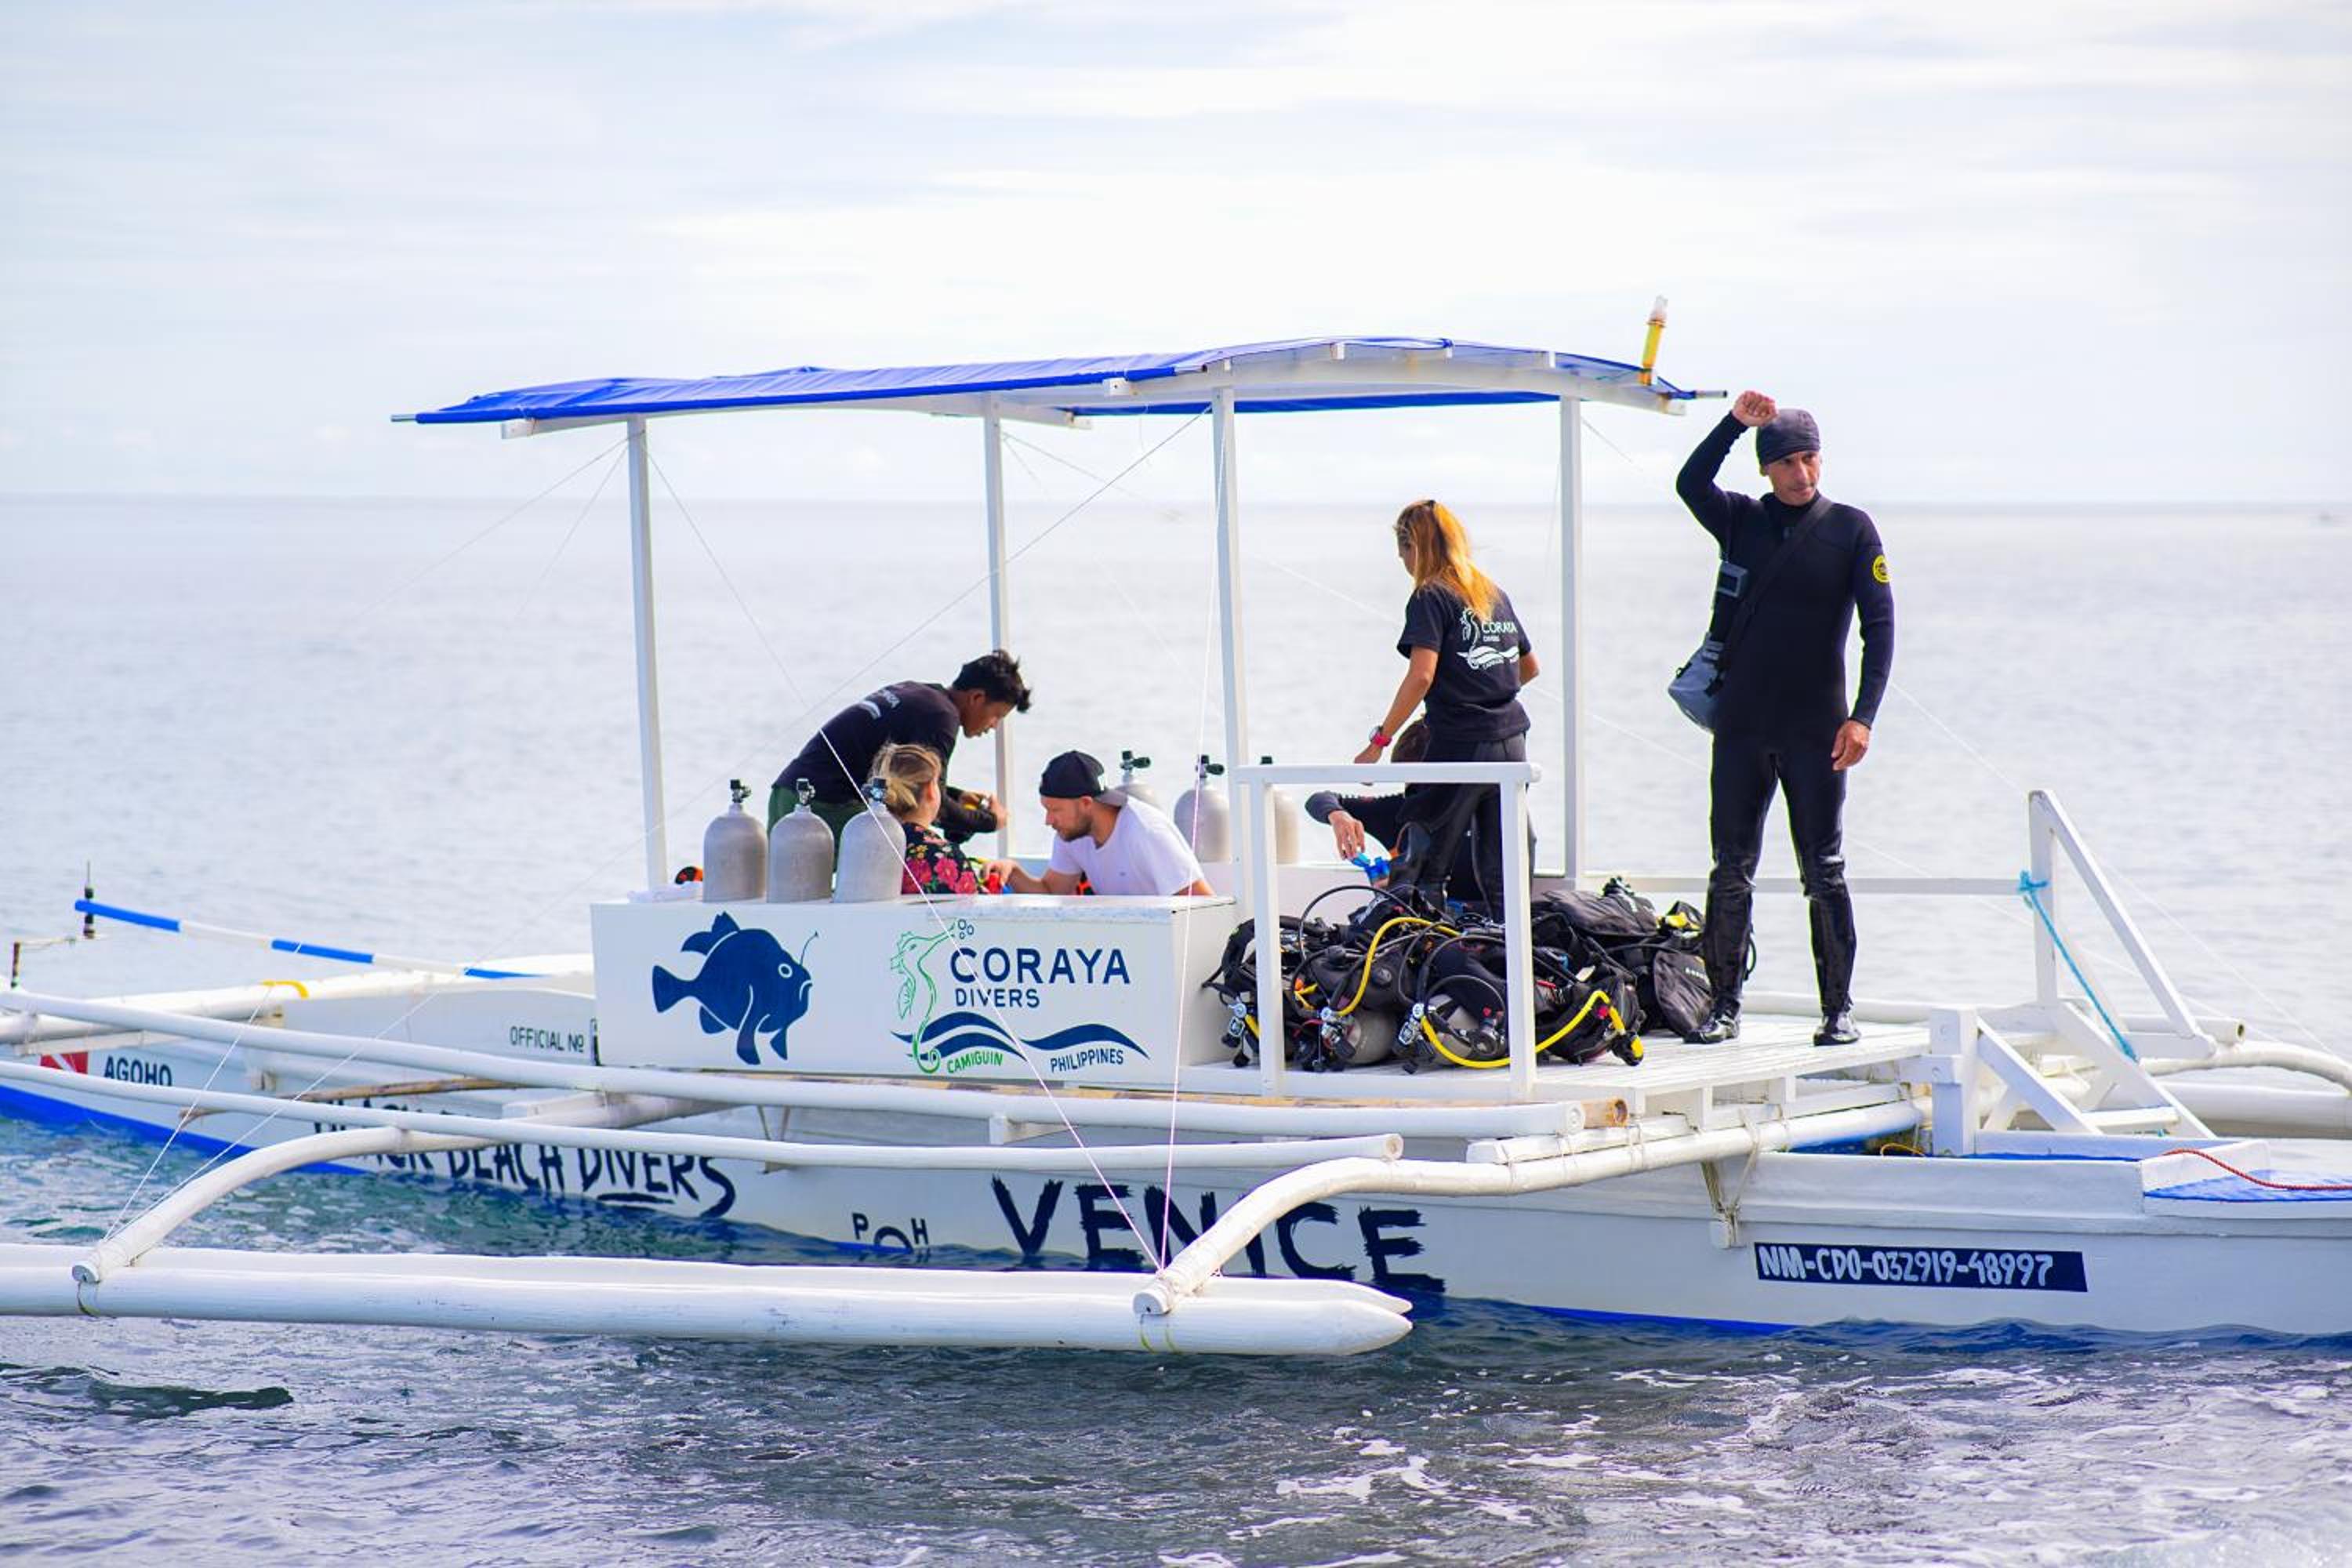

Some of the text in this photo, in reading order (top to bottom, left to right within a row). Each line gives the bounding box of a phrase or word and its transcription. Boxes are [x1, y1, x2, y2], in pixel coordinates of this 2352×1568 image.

[950, 947, 1131, 984] CORAYA
[956, 989, 1040, 1008] DIVERS
[510, 1025, 564, 1051] OFFICIAL
[103, 1055, 172, 1087] AGOHO
[946, 1048, 1124, 1074] CAMIGUIN PHILIPPINES
[577, 1146, 735, 1217] DIVERS
